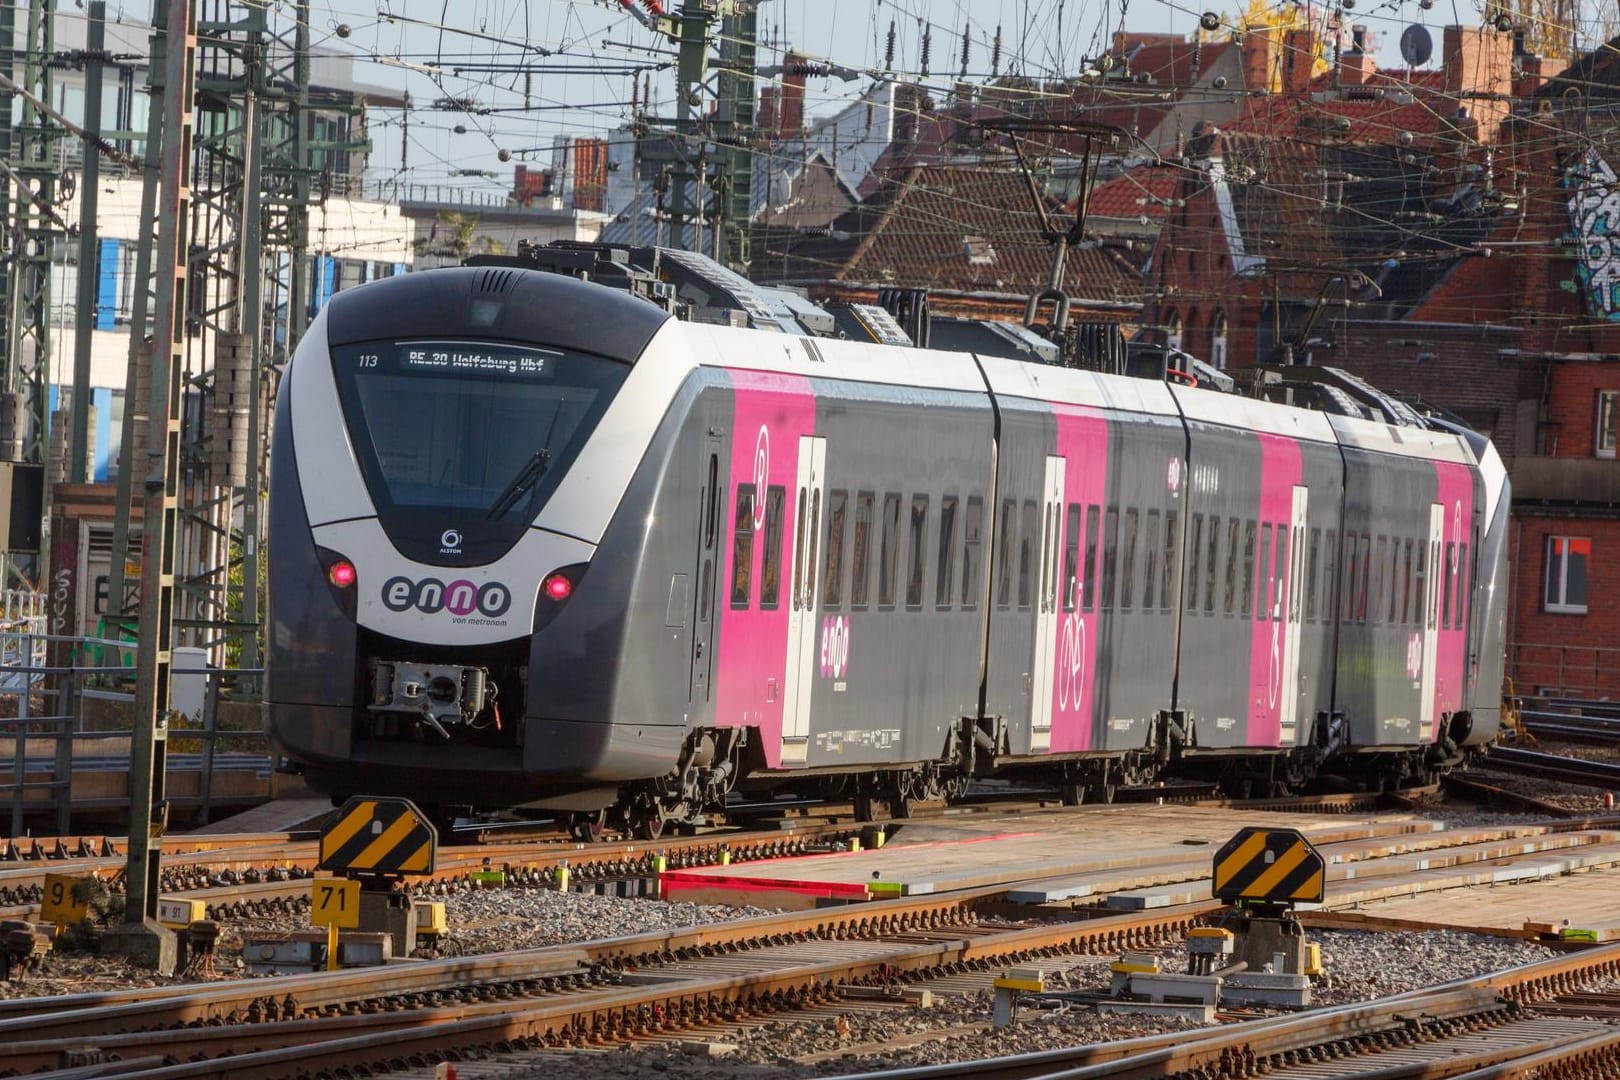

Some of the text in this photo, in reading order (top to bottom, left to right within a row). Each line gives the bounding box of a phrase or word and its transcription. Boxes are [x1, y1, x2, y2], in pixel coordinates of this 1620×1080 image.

[359, 355, 378, 367] 113
[452, 354, 517, 373] Wolfsburg
[520, 358, 545, 372] Hbf
[385, 579, 507, 613] enno
[452, 617, 467, 625] von
[321, 886, 346, 912] 71
